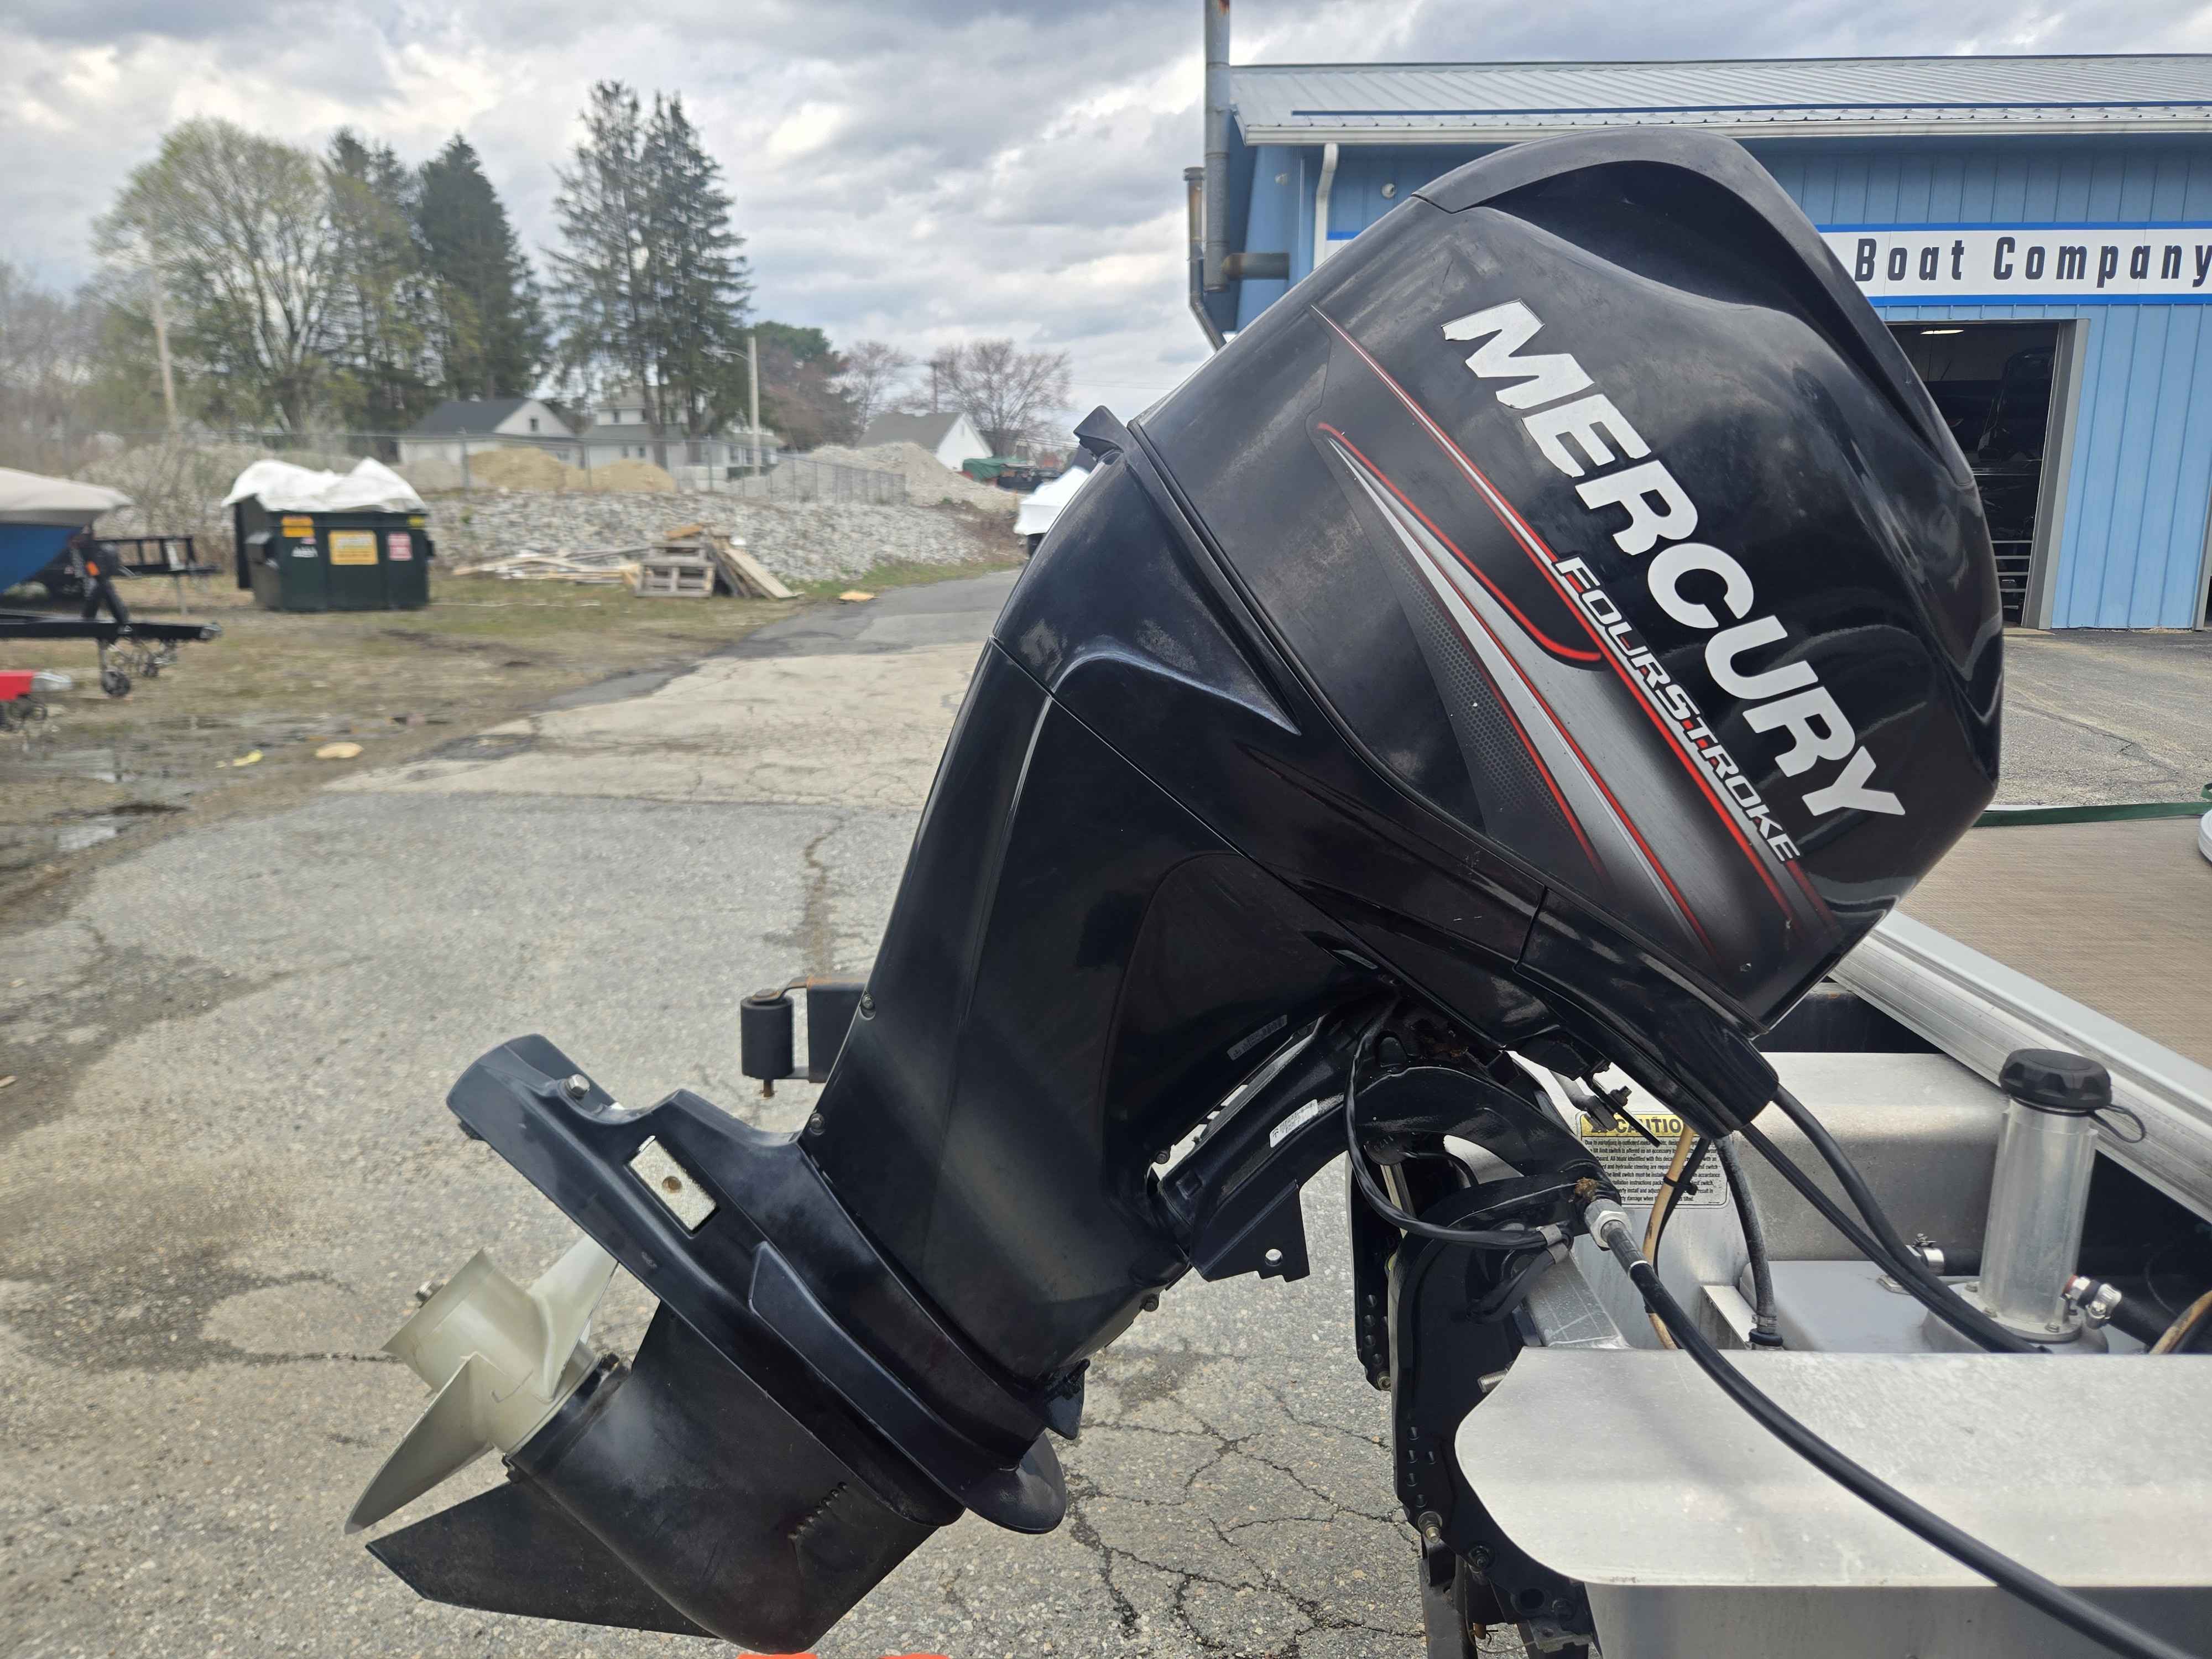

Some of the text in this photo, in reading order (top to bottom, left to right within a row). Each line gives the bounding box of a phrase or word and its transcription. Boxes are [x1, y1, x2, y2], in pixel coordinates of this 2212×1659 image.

[1854, 236, 2212, 288] Boat Company
[1441, 298, 1906, 816] MERCURY
[1555, 556, 1800, 862] FOURSTROKE
